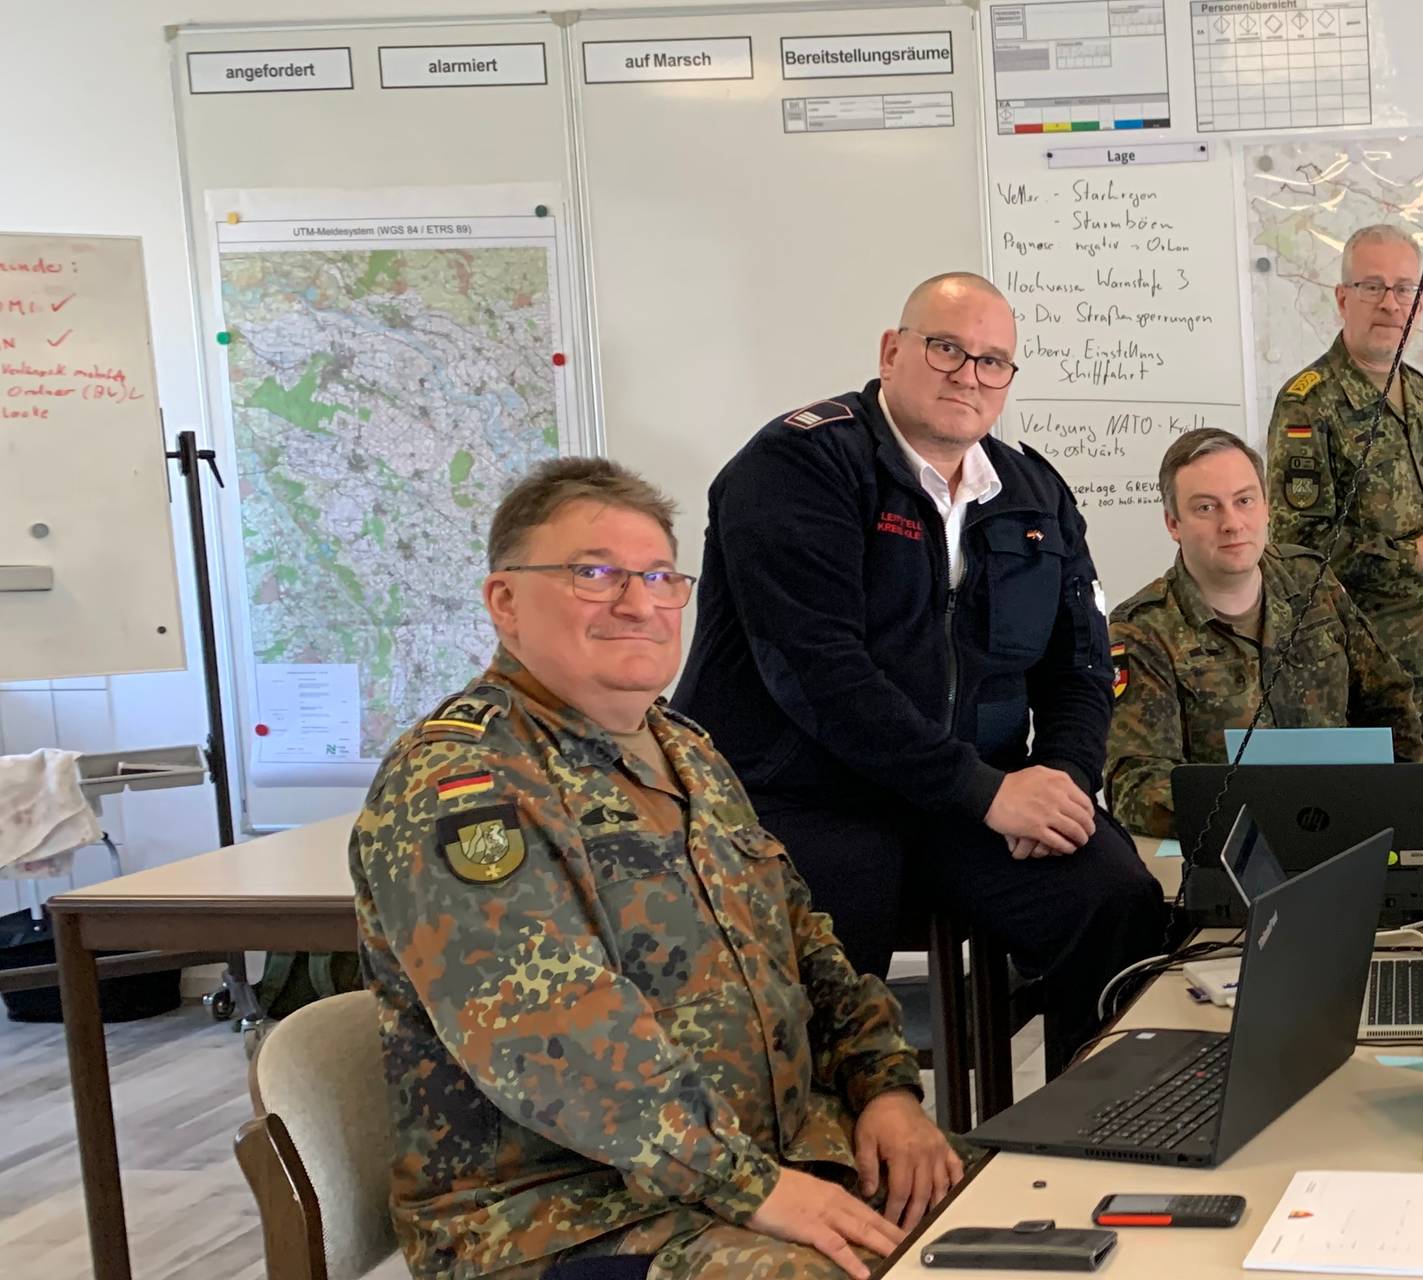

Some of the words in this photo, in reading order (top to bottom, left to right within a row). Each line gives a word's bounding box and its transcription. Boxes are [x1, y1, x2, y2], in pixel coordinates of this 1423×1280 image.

[1201, 0, 1297, 13] Personenübersicht
[428, 55, 499, 76] alarmiert
[625, 52, 652, 69] auf
[652, 51, 712, 69] Marsch
[784, 45, 950, 66] Bereitstellungsräume
[225, 61, 316, 82] angefordert
[1107, 150, 1136, 165] Lage
[292, 227, 375, 238] UTM-Meldesystem
[406, 225, 419, 235] 84
[426, 225, 454, 235] ETRS
[1177, 268, 1190, 291] 3
[1019, 411, 1097, 443] Verlegung
